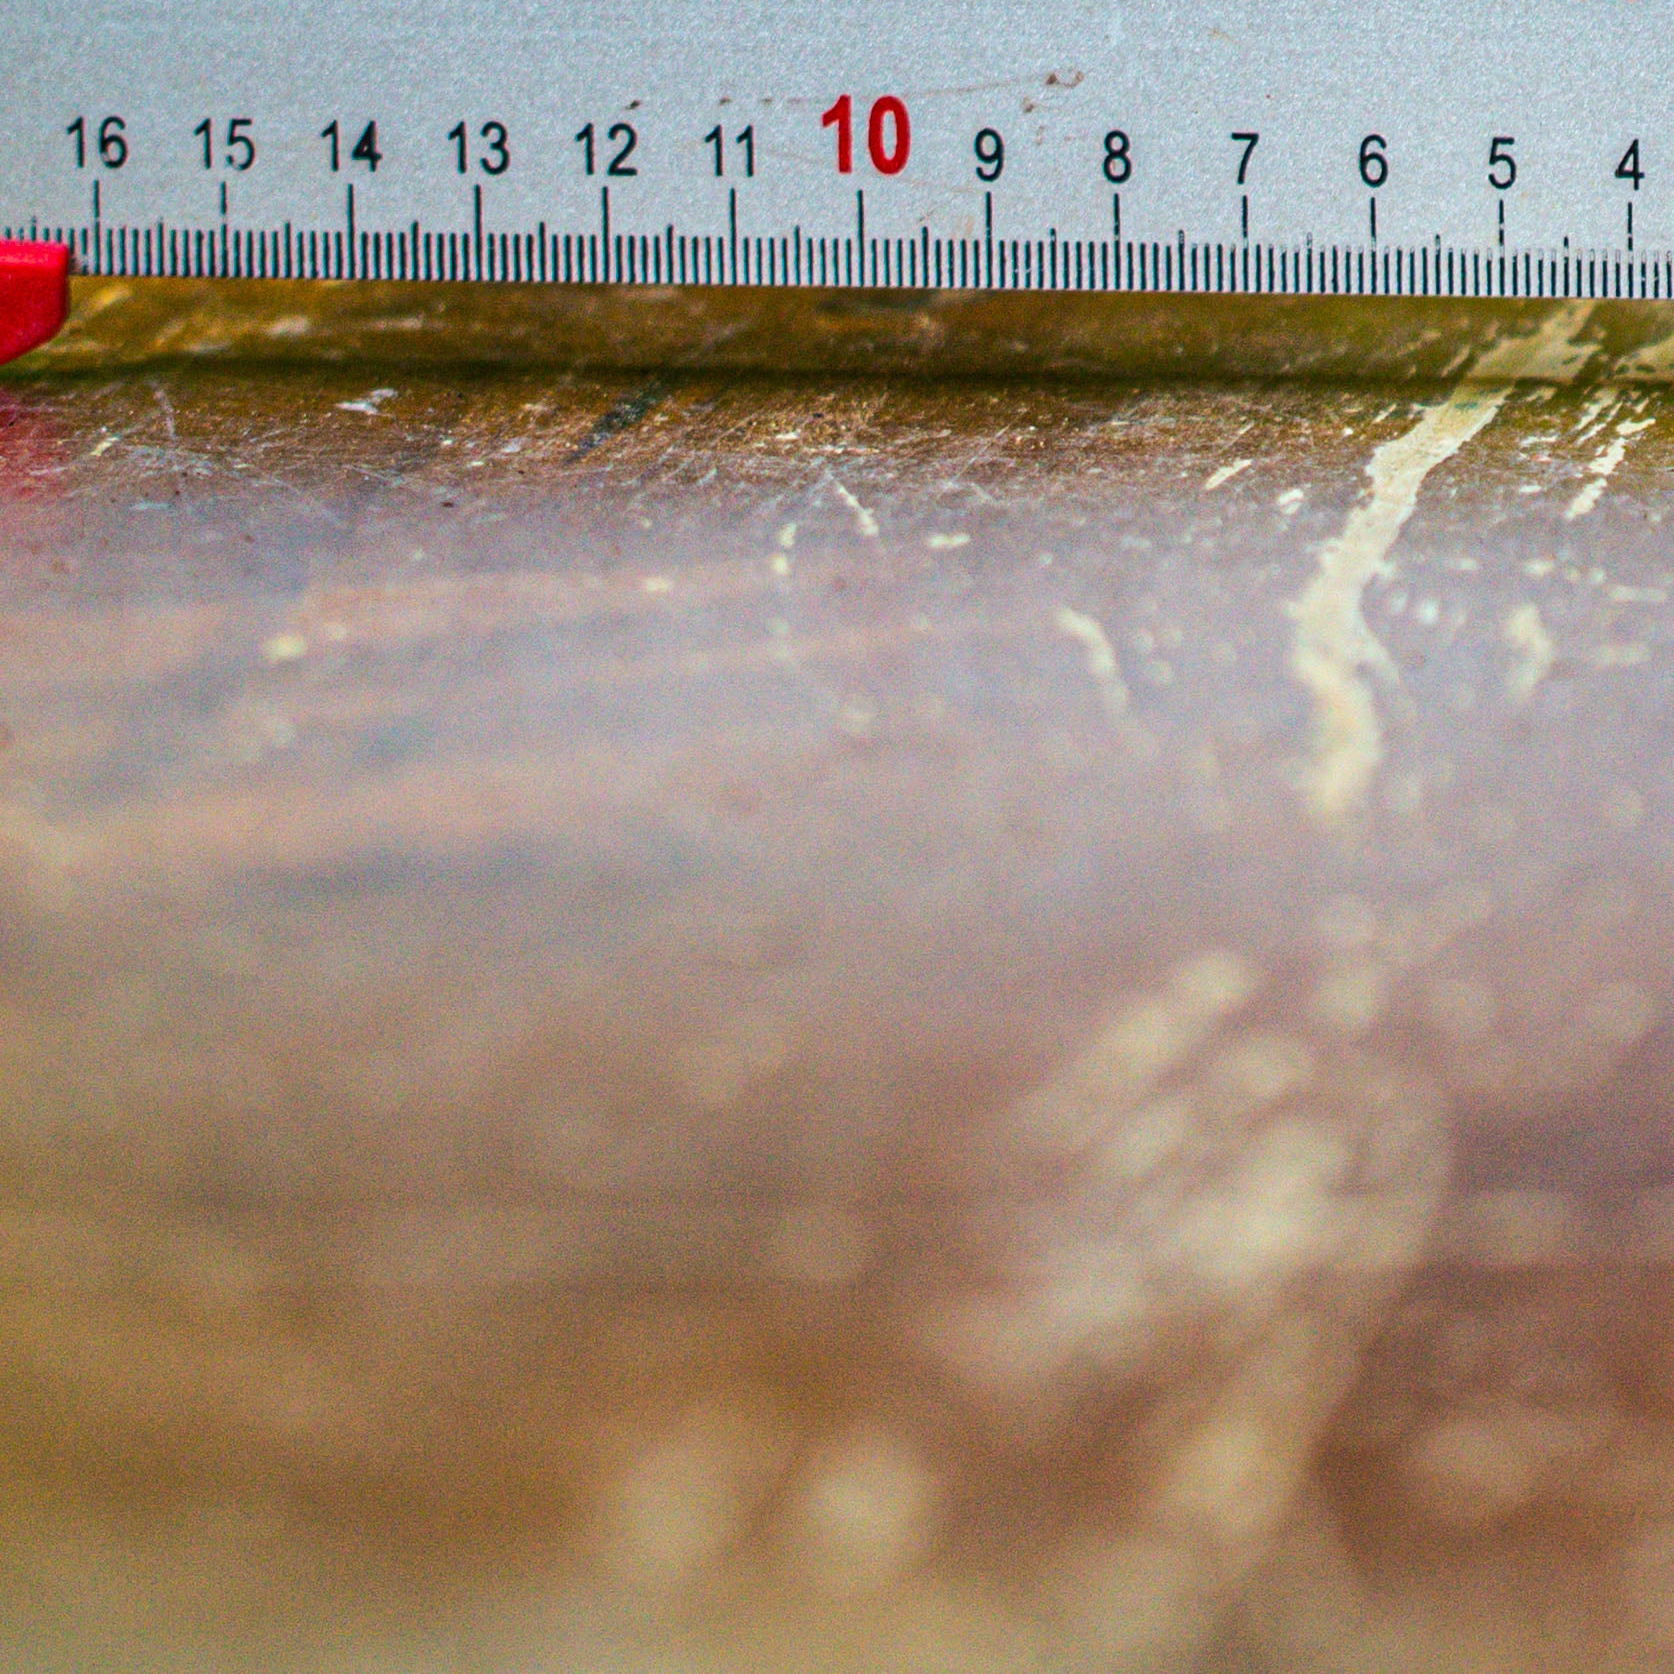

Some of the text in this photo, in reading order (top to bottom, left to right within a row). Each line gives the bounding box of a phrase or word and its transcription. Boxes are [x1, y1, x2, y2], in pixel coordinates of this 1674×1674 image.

[67, 115, 129, 169] 16
[194, 118, 256, 171] 15
[321, 120, 383, 172] 14
[448, 120, 510, 175] 13
[576, 122, 638, 177] 12
[705, 124, 755, 177] 11
[821, 94, 911, 175] 10
[974, 127, 1004, 182] 9
[1103, 129, 1132, 184] 8
[1231, 132, 1260, 185] 7
[1359, 133, 1389, 188] 6
[1488, 136, 1517, 190] 5
[1614, 138, 1645, 191] 4
